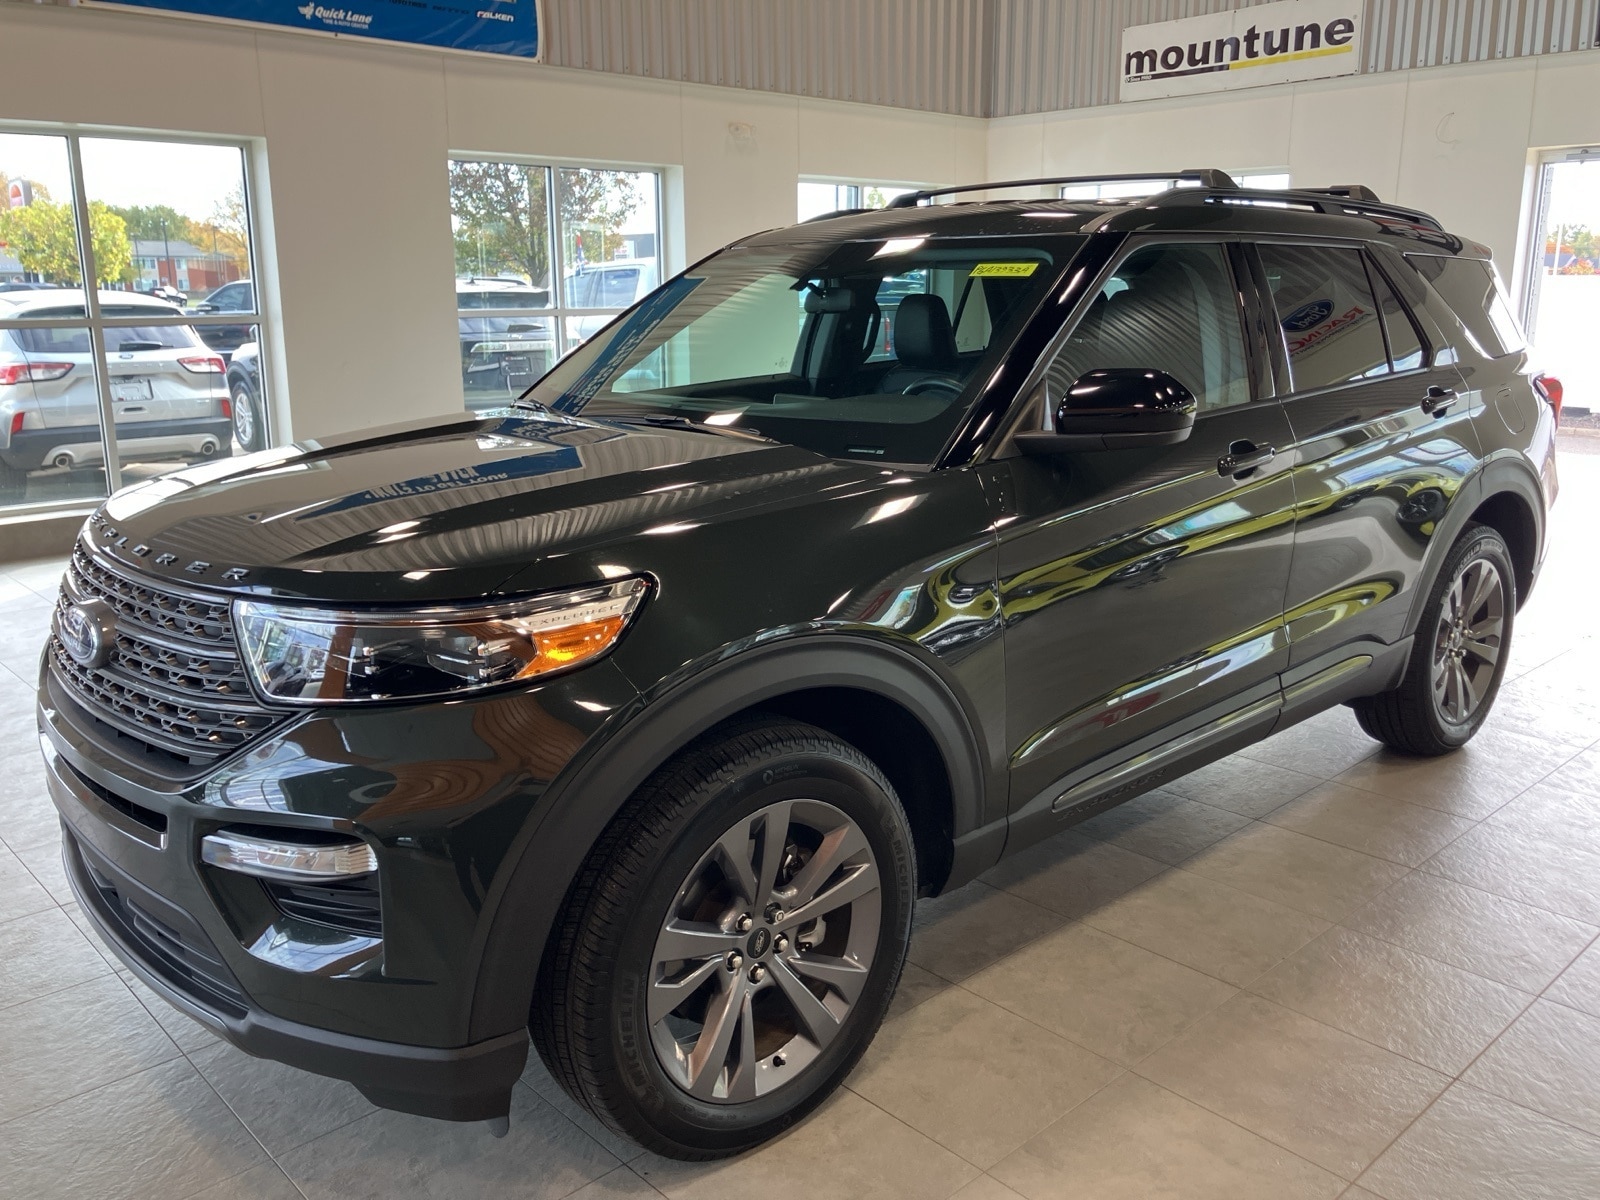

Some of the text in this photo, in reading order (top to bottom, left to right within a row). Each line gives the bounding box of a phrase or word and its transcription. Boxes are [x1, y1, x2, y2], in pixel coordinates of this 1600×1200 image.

[315, 6, 372, 24] Quick Lane
[476, 10, 514, 22] FALKEN
[1125, 17, 1355, 75] mountune
[91, 513, 250, 583] EXPLORER
[621, 977, 647, 1088] MICHELIN
